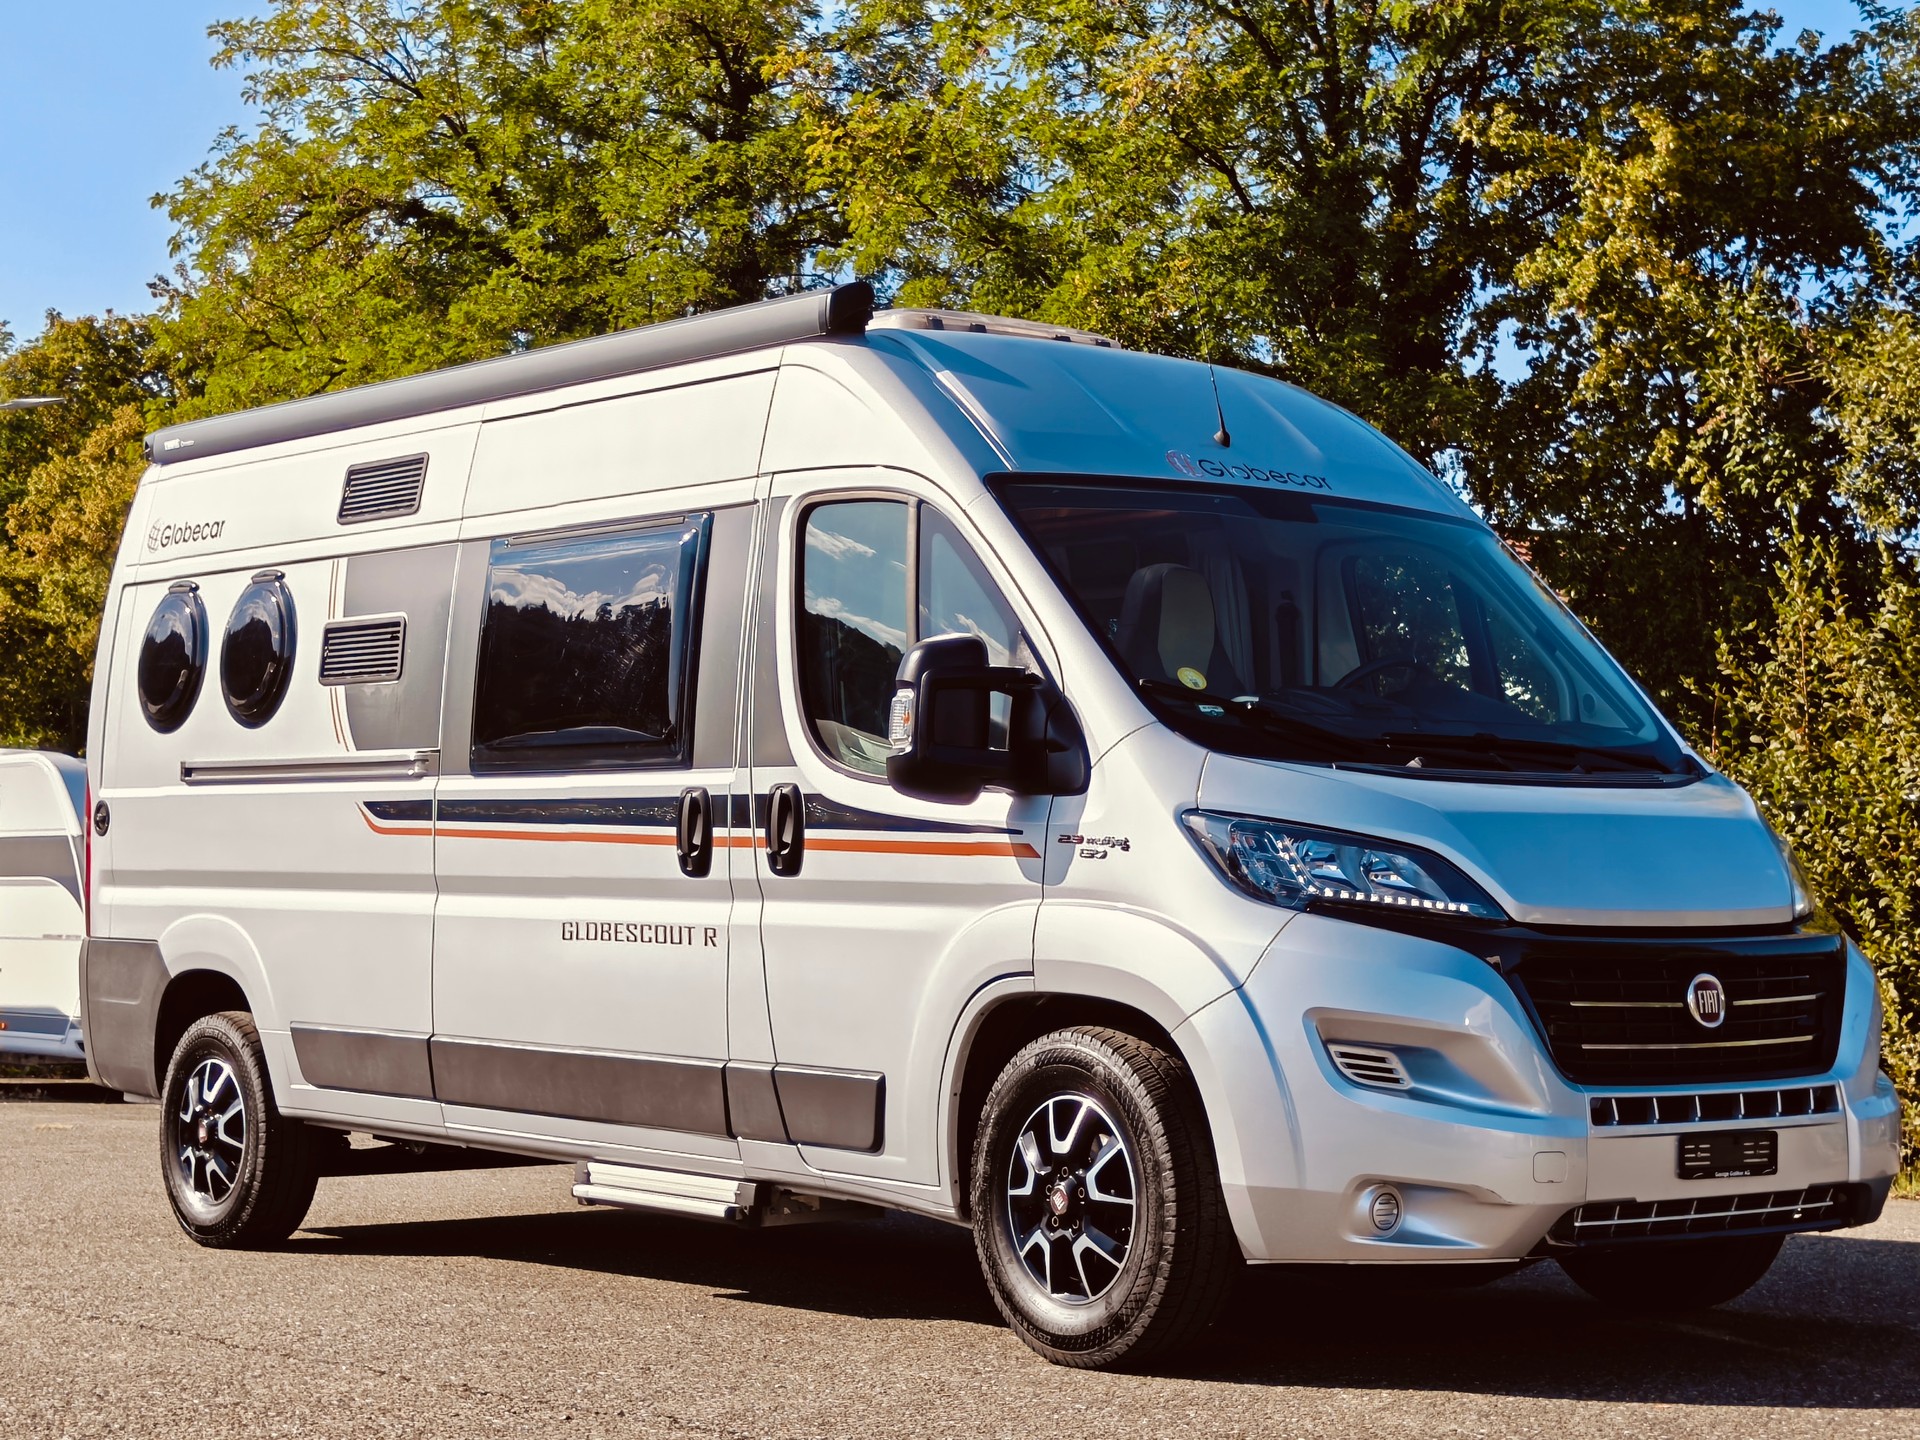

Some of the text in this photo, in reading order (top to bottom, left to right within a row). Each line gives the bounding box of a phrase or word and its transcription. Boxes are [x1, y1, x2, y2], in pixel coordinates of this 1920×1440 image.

[1198, 459, 1333, 490] Globecar
[161, 520, 225, 548] Globecar
[562, 921, 717, 947] GLOBESCOUT R
[1697, 990, 1718, 1014] FIAT
